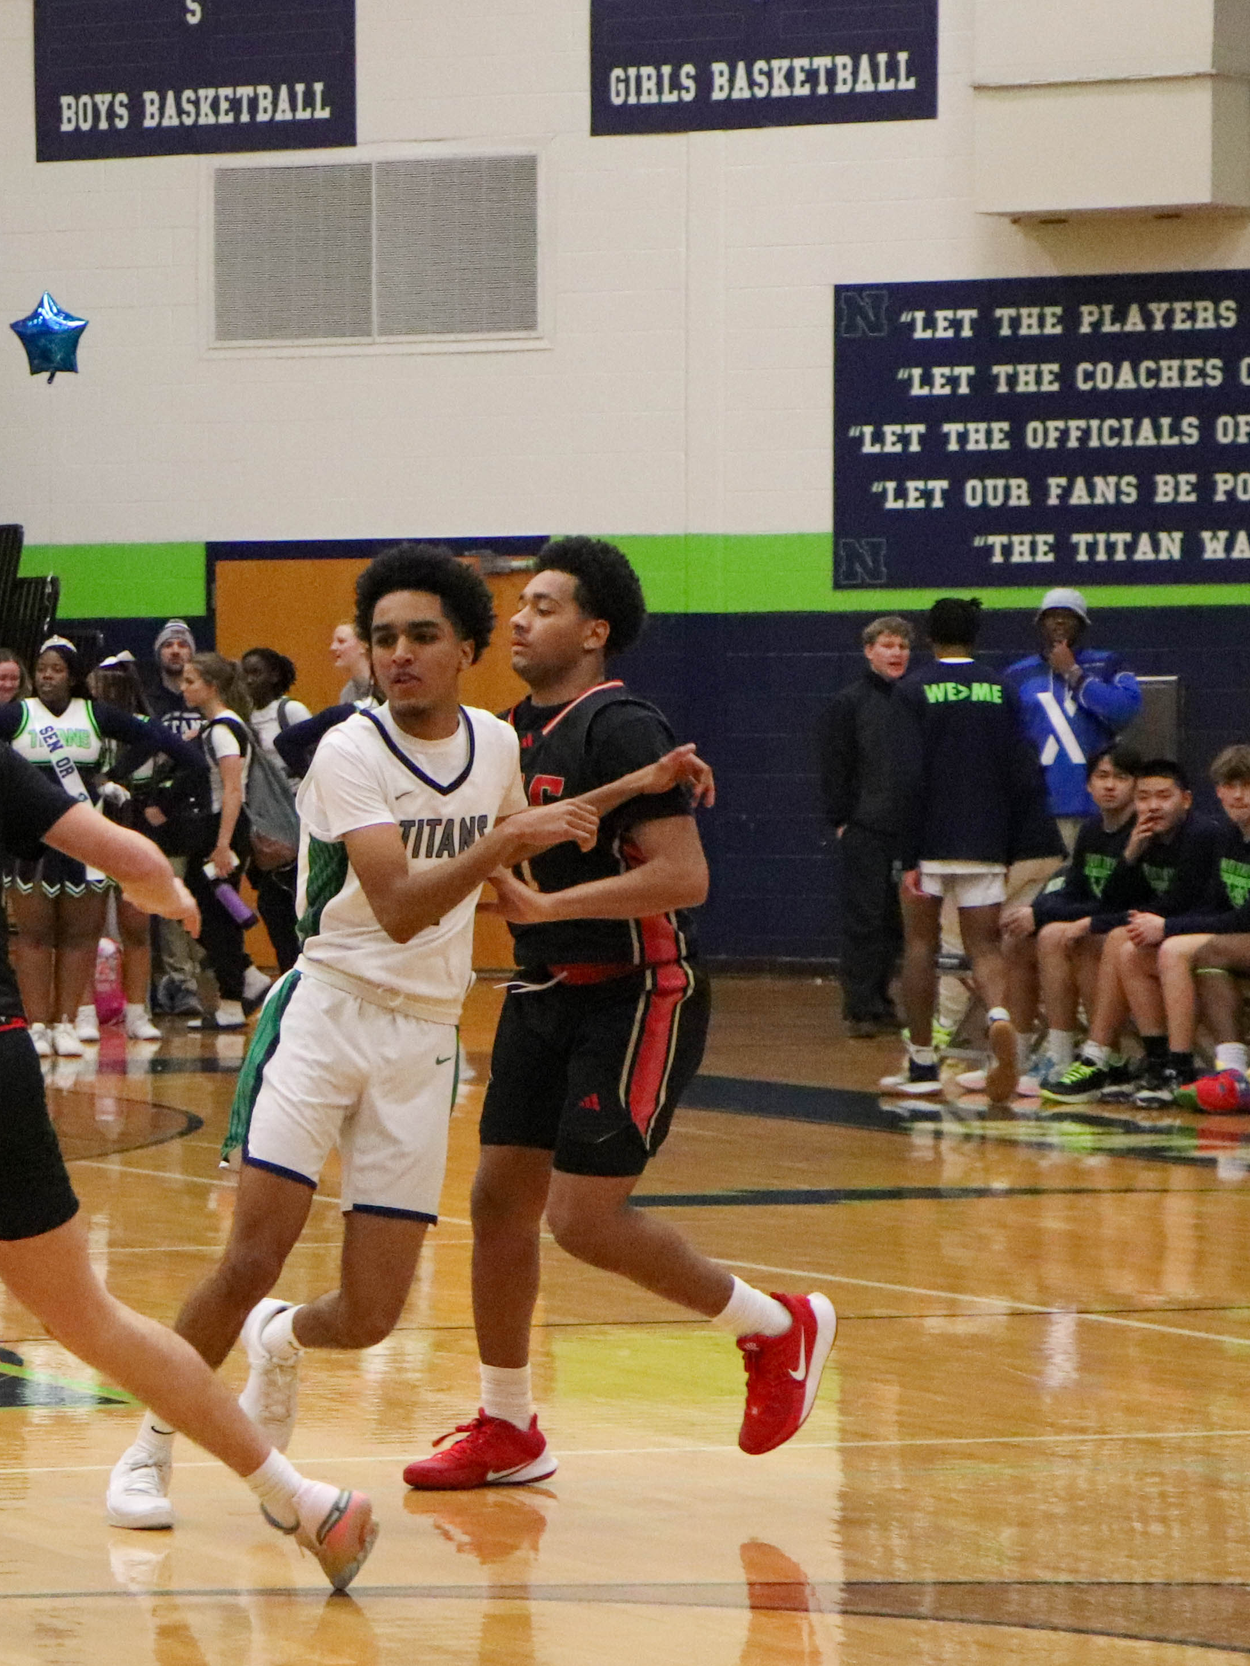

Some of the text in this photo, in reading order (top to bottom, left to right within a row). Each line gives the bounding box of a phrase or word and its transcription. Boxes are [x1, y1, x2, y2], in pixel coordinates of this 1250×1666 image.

[610, 51, 916, 105] GIRLS BASKETBALL
[60, 82, 330, 132] BOYS BASKETBALL
[995, 307, 1063, 336] THE
[1079, 300, 1238, 333] PLAYERS
[992, 363, 1060, 393] THE
[1077, 358, 1224, 390] COACHES
[943, 422, 1010, 450] THE
[1026, 416, 1199, 449] OFFICIALS
[965, 478, 1030, 507] OUR
[1047, 476, 1138, 505] FANS
[1154, 474, 1198, 502] BE
[1071, 531, 1184, 561] TITAN
[399, 814, 488, 859] TITANS
